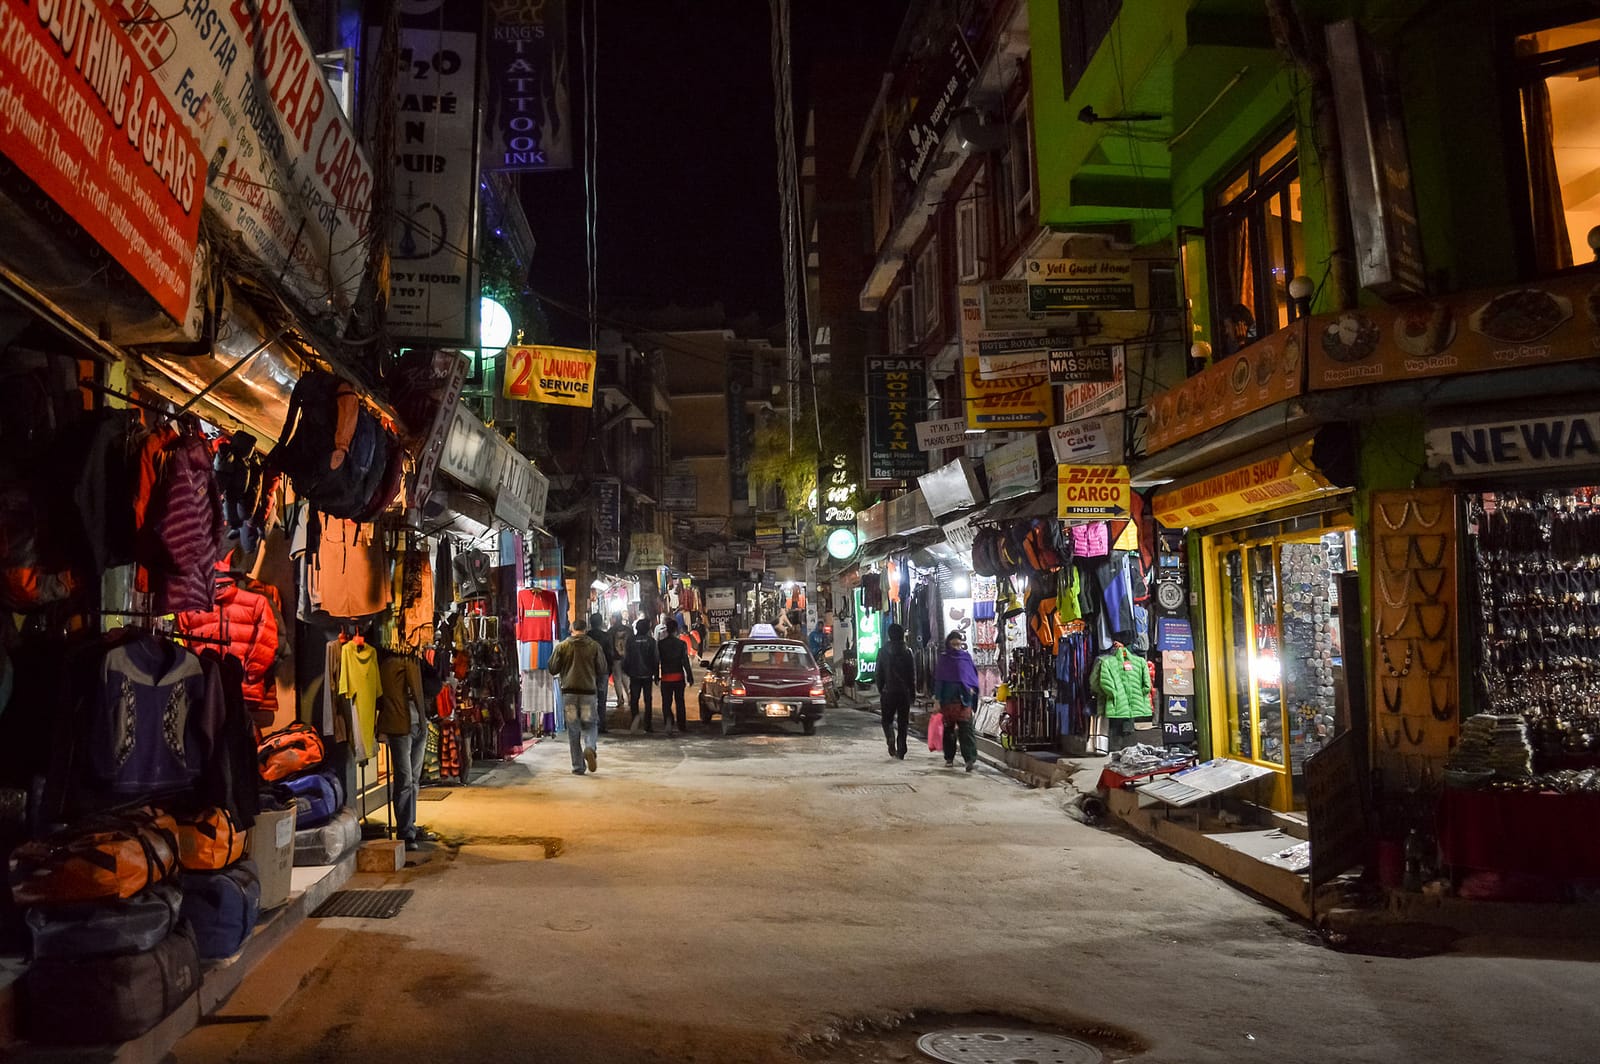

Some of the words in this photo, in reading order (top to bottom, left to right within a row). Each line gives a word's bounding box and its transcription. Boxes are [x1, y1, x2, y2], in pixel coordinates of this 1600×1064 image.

[494, 26, 545, 40] KING'S
[174, 67, 213, 133] FedEx
[507, 39, 536, 151] TATTOO
[127, 74, 143, 150] &
[143, 96, 196, 215] GEARS
[504, 152, 546, 164] INK
[1047, 263, 1065, 276] Yeti
[1052, 351, 1074, 359] MONA
[870, 360, 923, 370] PEAK
[1050, 358, 1109, 373] MASSAGE
[510, 349, 531, 398] 2
[543, 358, 592, 381] LAUNDRY
[539, 378, 589, 393] SERVICE
[886, 372, 909, 450] MOUNTAIN
[1057, 427, 1080, 440] Cookie
[1067, 434, 1096, 446] Cafe
[1069, 468, 1120, 484] DHL
[1253, 459, 1279, 484] SHOP
[1067, 486, 1120, 502] CARGO
[825, 507, 856, 521] Pub
[711, 609, 733, 617] VISION
